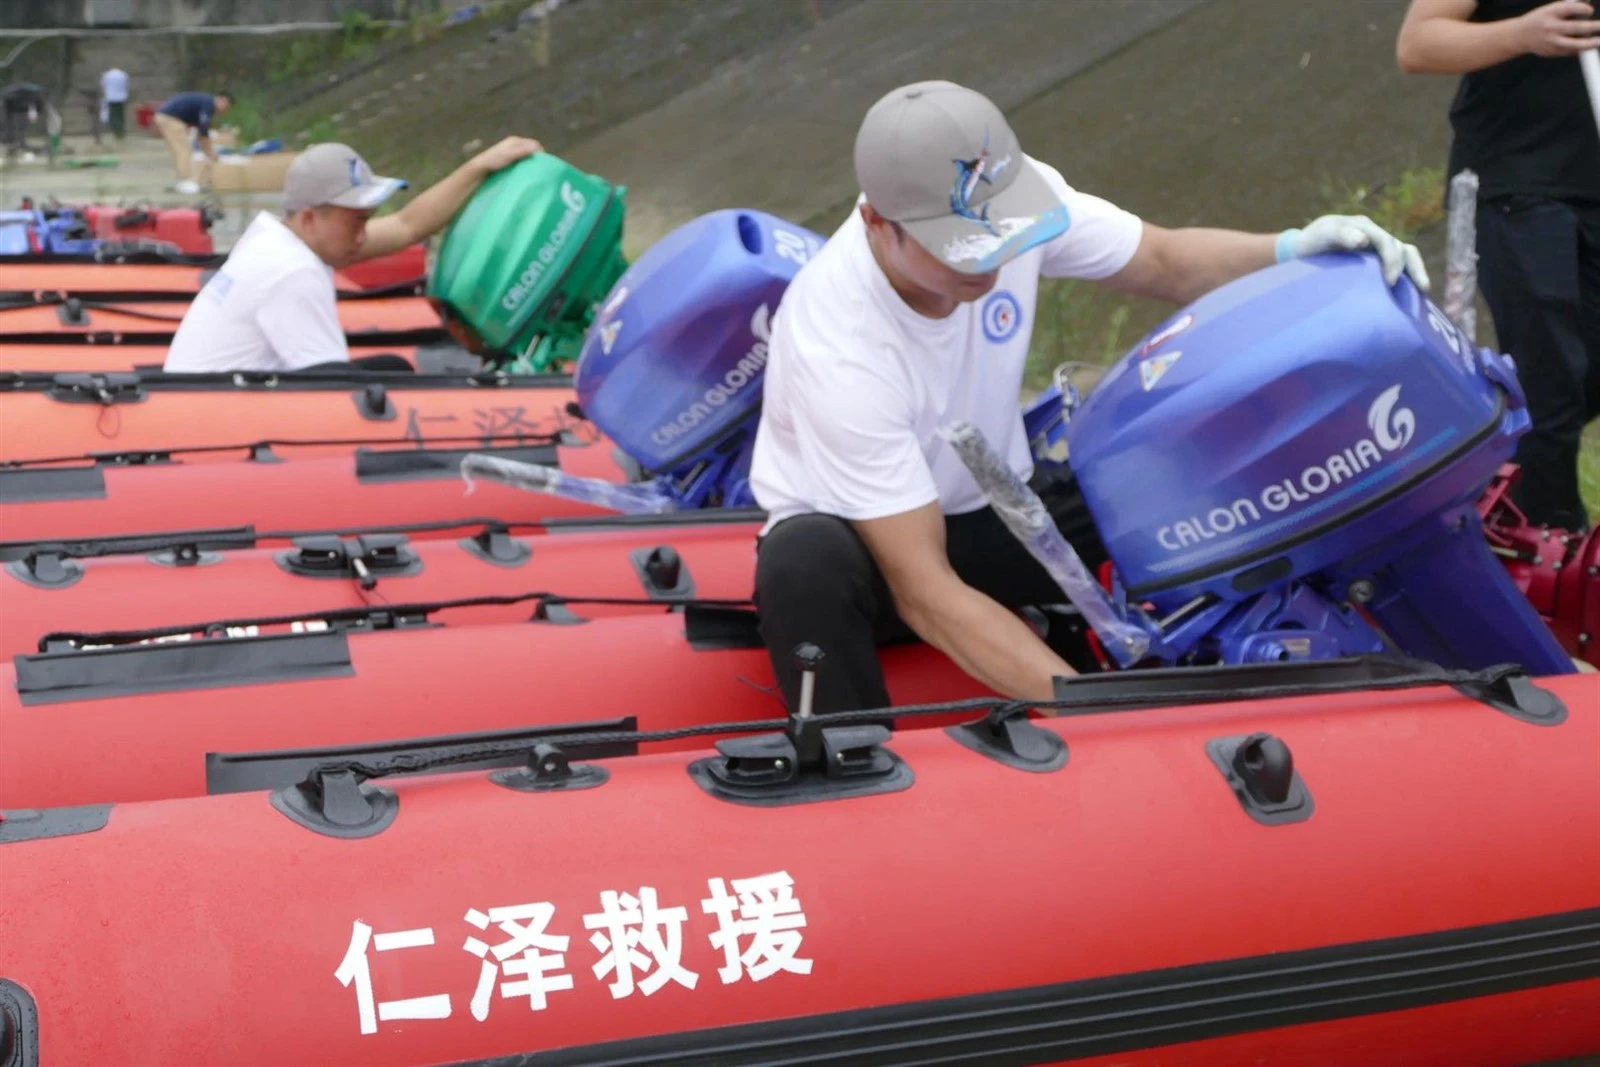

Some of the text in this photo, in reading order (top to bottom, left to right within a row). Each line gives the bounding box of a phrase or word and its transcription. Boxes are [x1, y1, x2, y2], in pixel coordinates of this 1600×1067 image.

[651, 342, 769, 445] CALON GLORIA
[1157, 438, 1382, 550] CALON GLORIA
[334, 870, 813, 1035] 仁泽救援
